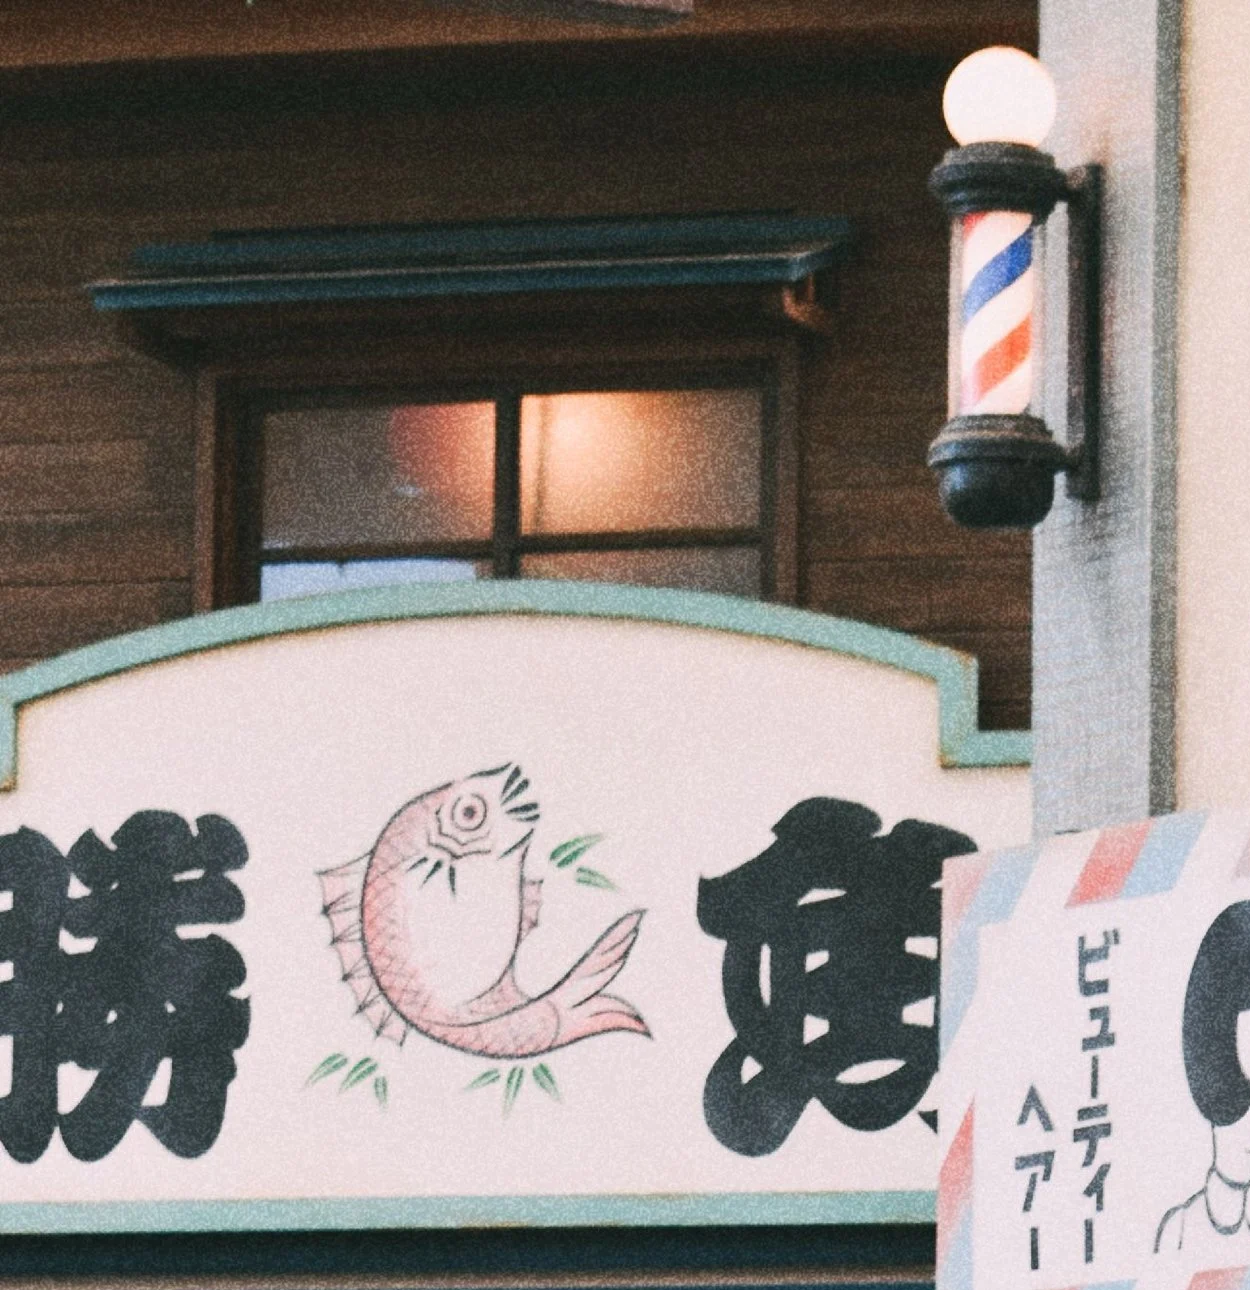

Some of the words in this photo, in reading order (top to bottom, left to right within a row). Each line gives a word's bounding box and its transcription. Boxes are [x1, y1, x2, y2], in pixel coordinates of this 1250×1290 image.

[1013, 1082, 1056, 1271] ヘアー
[1072, 927, 1121, 1265] ビューティー
